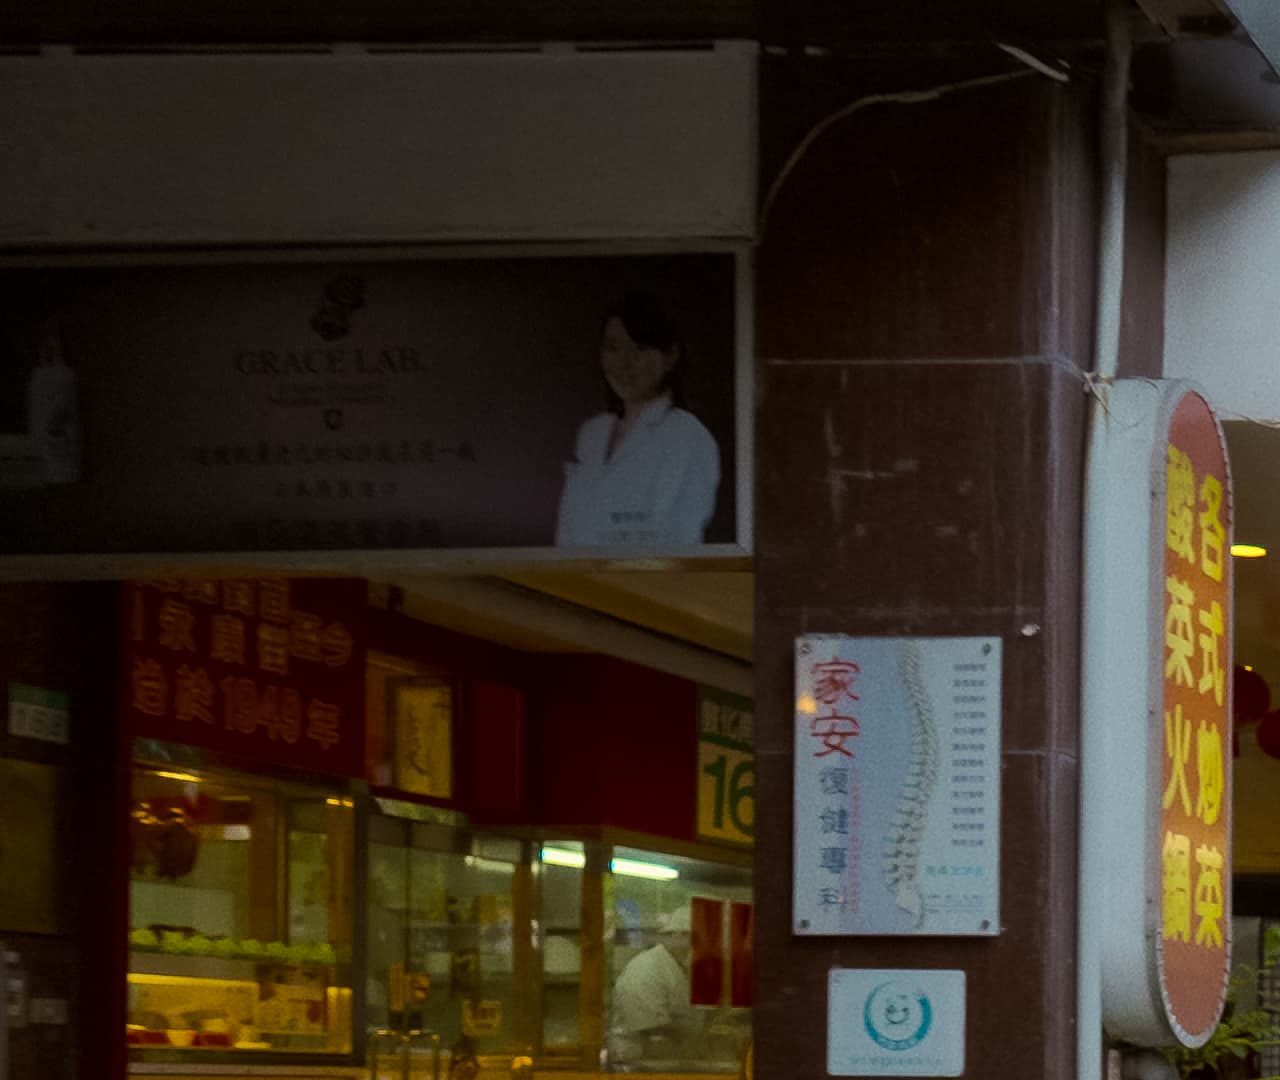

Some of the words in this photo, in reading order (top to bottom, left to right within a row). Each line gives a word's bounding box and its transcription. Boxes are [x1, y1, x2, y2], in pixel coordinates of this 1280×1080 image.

[233, 348, 345, 376] GRACE
[810, 656, 861, 759] 家安
[1162, 443, 1196, 943] 酸菜火鍋
[1195, 472, 1226, 949] 各式炒菜
